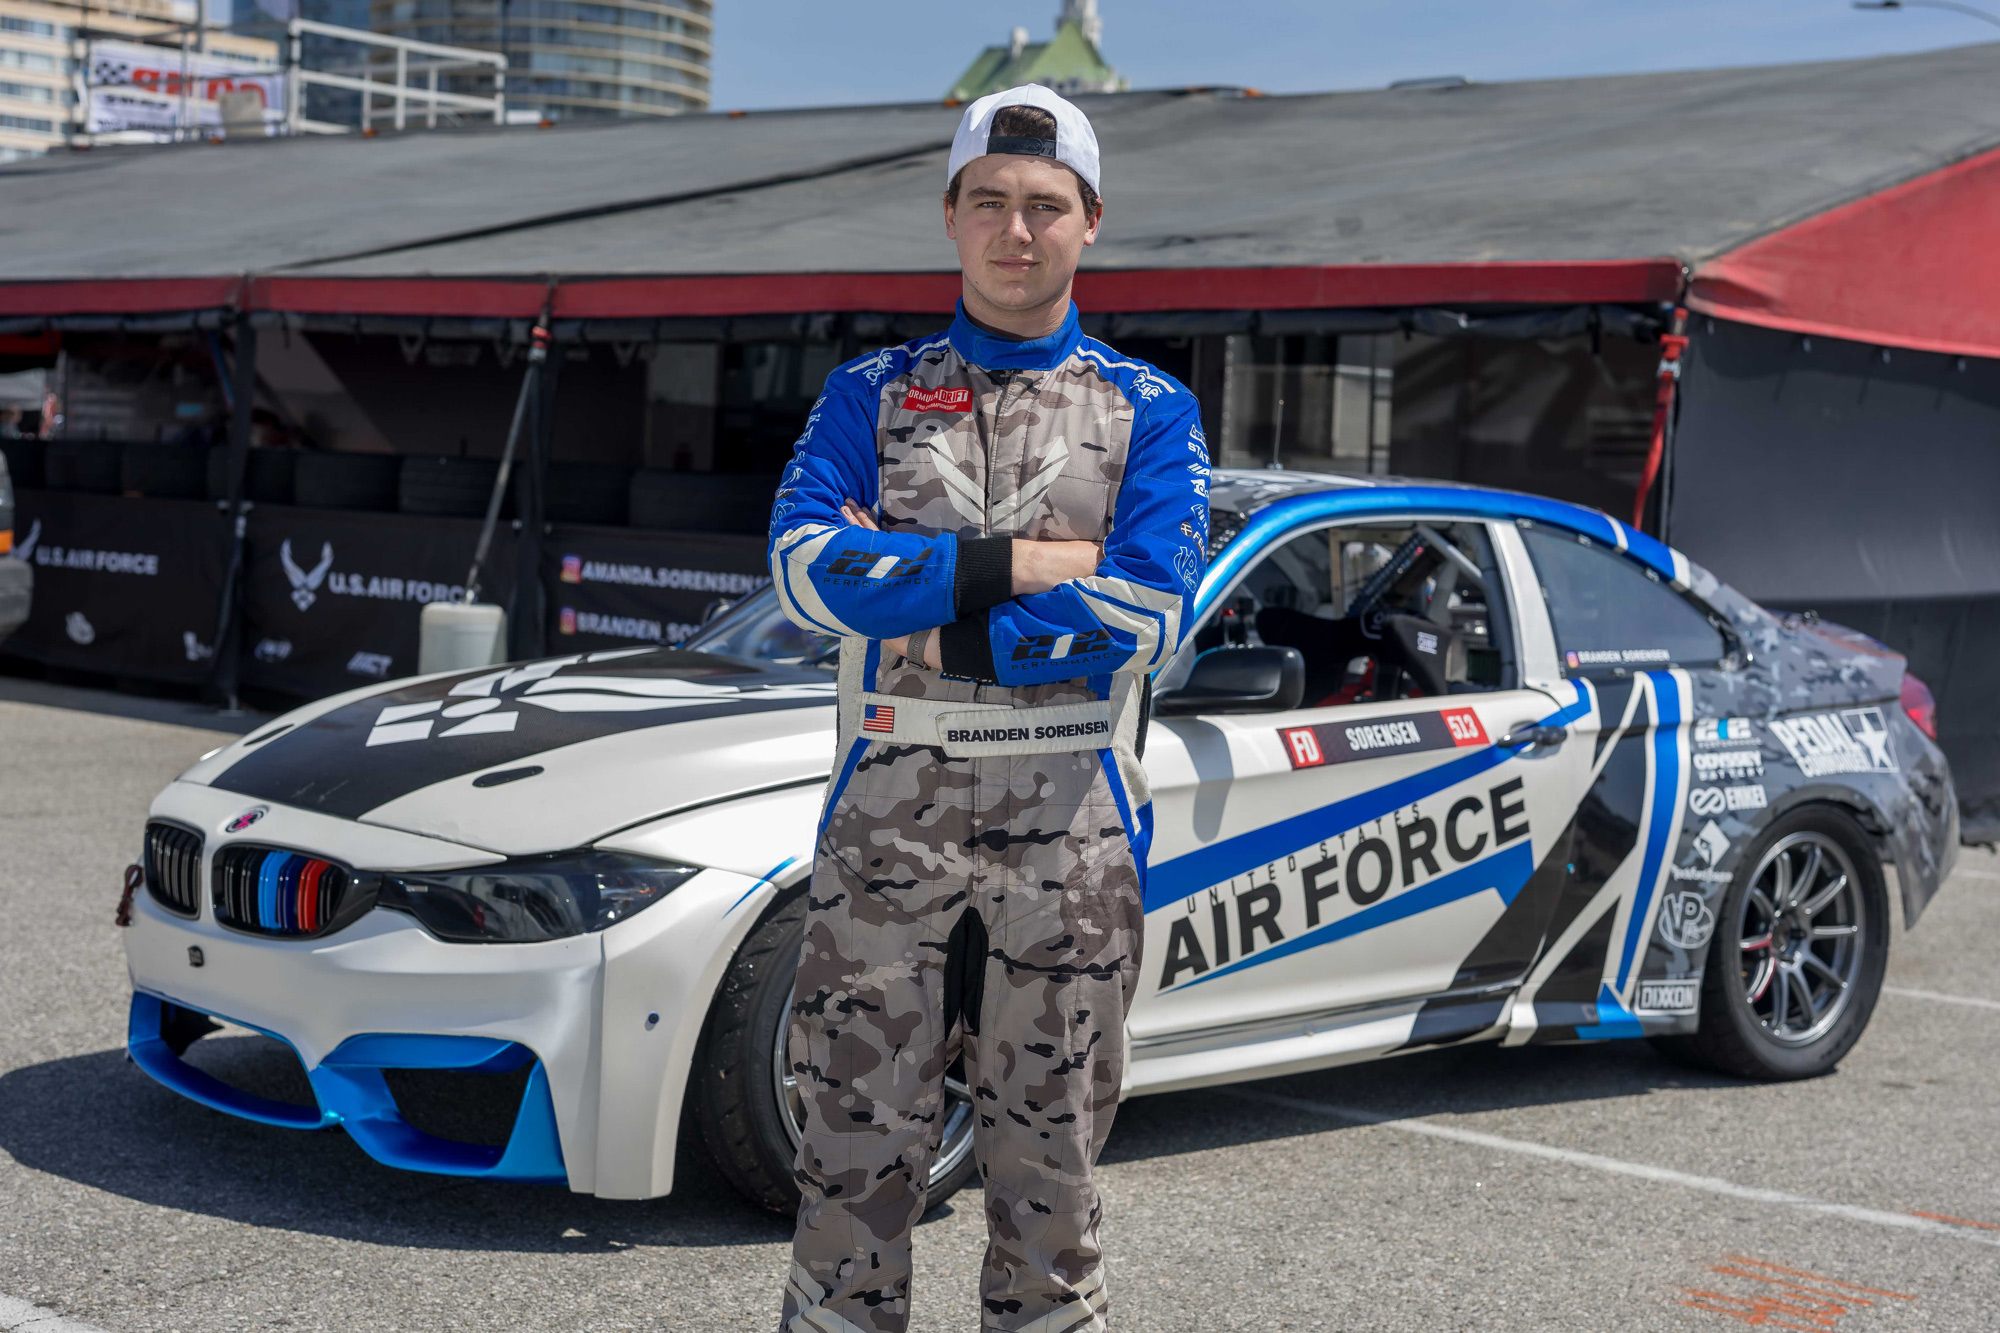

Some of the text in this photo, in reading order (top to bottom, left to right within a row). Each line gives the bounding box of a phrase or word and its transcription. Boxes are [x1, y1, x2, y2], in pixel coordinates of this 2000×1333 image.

[939, 389, 969, 403] DRIFT
[35, 546, 159, 576] U.S. AIR FORCE
[327, 571, 475, 604] U.S. AIR FORC
[823, 577, 932, 588] PERFORMANCE
[1011, 628, 1112, 662] 212
[1011, 652, 1121, 671] PERFORMANCE
[947, 720, 1109, 743] BRANDEN SORENSEN
[1345, 720, 1421, 751] SORENSEN
[1446, 714, 1479, 741] 513
[1767, 712, 1862, 760] PEDAL
[1291, 730, 1320, 763] FD
[1724, 784, 1768, 811] ENKEI
[1187, 803, 1420, 914] UNITED STATES
[1158, 775, 1530, 990] AIR FORCE
[1641, 984, 1694, 1009] DIXXON
